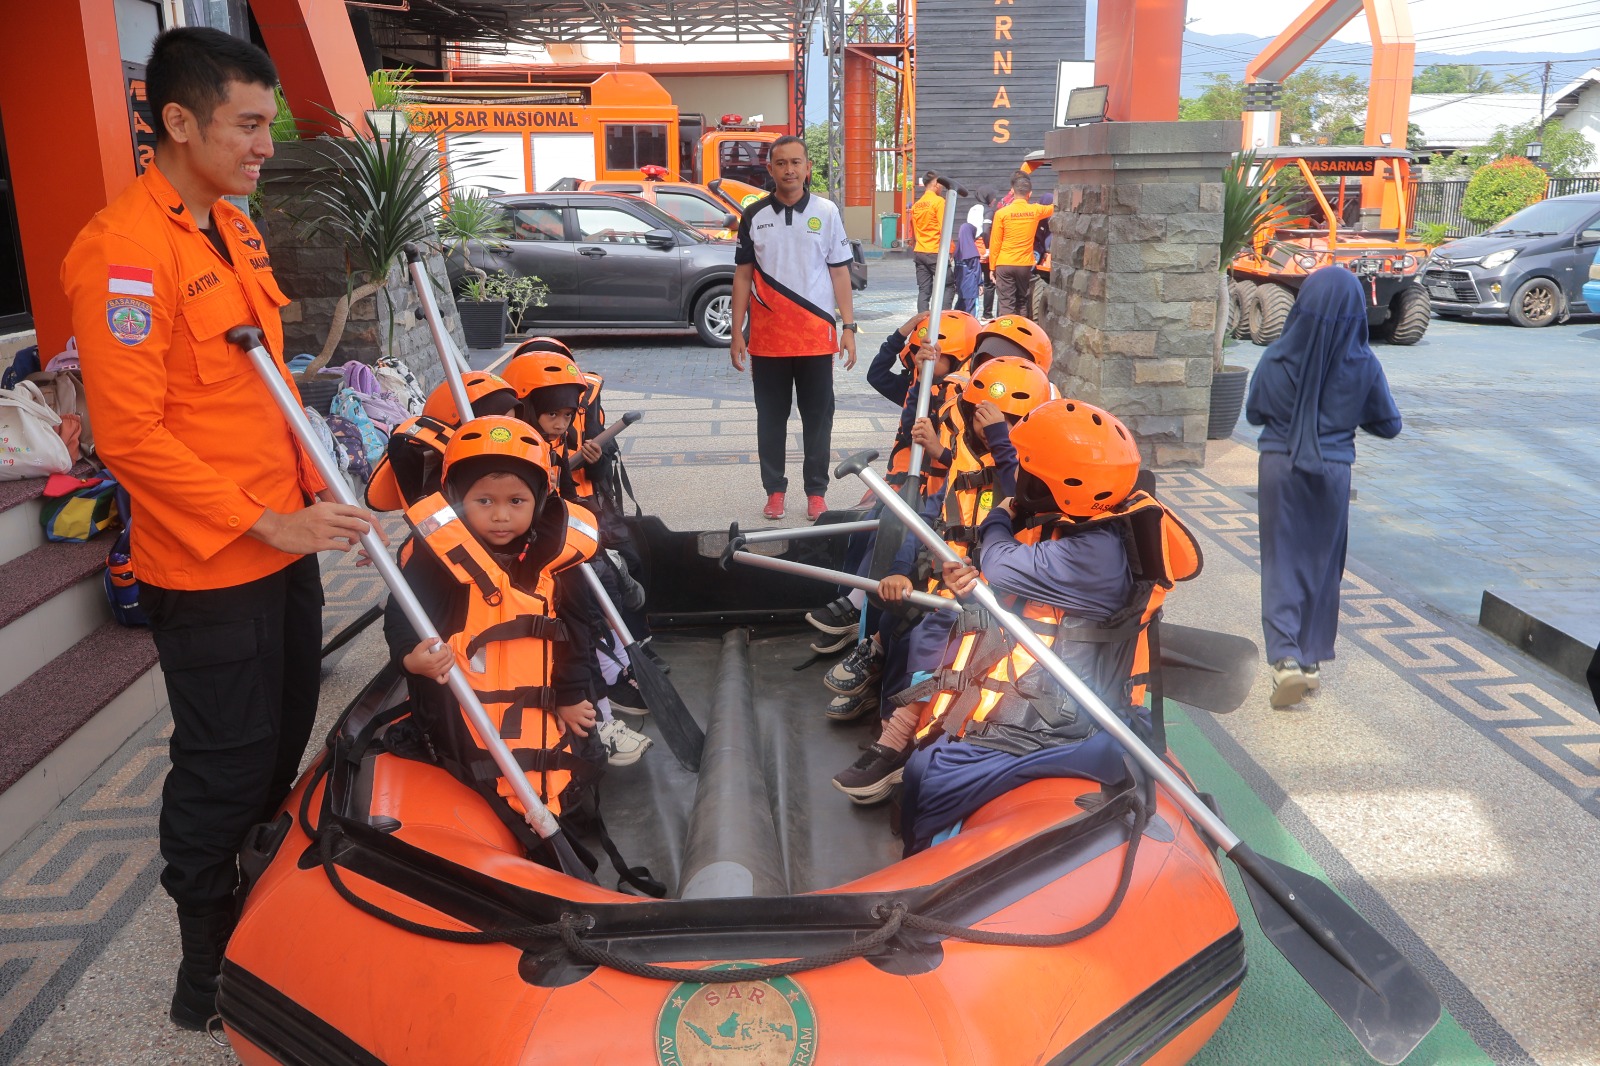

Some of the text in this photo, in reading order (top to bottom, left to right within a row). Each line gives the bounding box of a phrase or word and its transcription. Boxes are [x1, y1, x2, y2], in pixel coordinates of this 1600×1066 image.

[992, 0, 1014, 143] RNAS
[455, 110, 488, 127] SAR
[493, 111, 578, 127] NASIONAL
[187, 271, 220, 297] SATRIA
[109, 298, 150, 314] BASARNAS
[704, 984, 765, 1007] SAR
